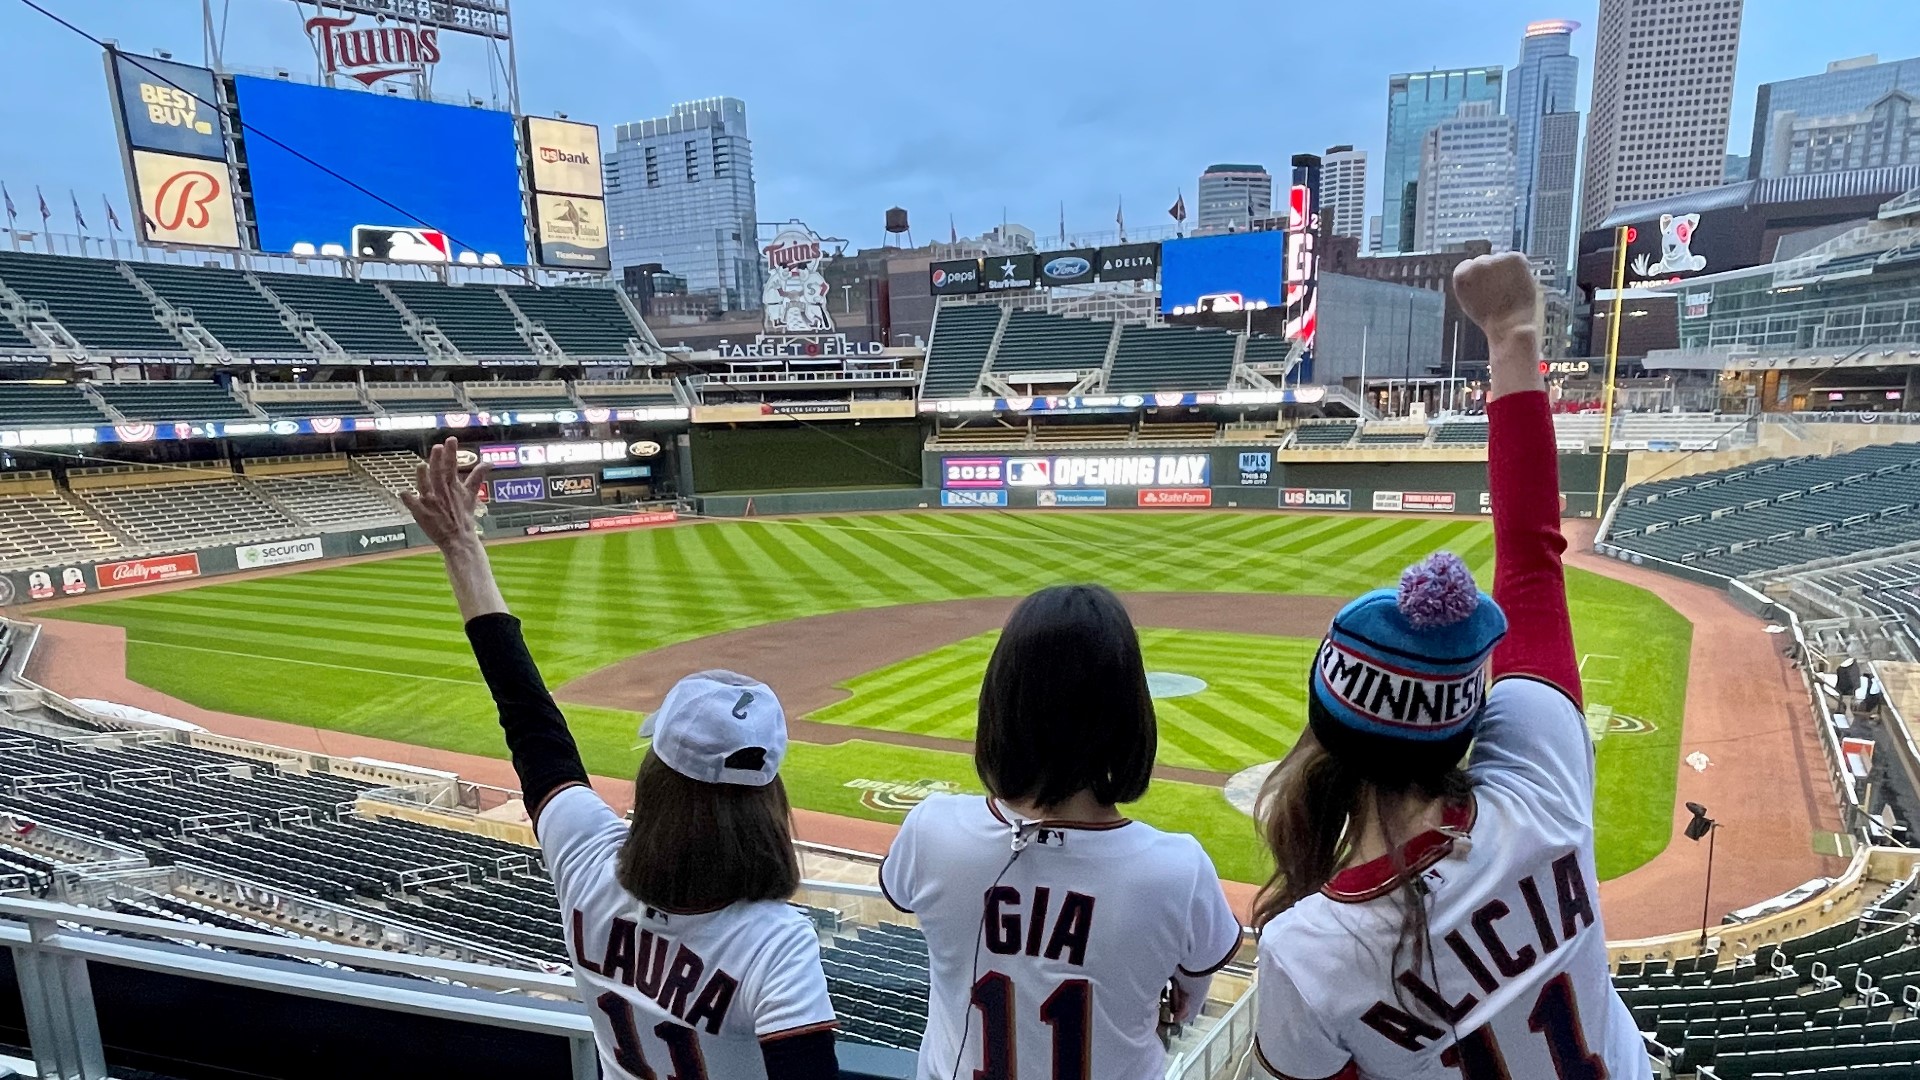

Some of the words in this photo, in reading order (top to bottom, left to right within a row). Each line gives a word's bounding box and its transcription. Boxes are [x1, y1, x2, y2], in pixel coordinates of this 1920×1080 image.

[304, 11, 441, 76] Twins
[140, 83, 199, 111] BEST
[147, 103, 197, 129] BUY
[155, 170, 220, 231] B
[763, 240, 821, 270] Twins
[1115, 256, 1153, 268] DELTA
[947, 269, 976, 284] pepsi
[1052, 262, 1081, 276] Ford
[718, 343, 802, 357] TARGET
[823, 341, 884, 356] FIELD
[1550, 361, 1590, 373] FIELD
[947, 466, 1001, 480] 2022
[1054, 456, 1156, 485] OPENING
[1242, 454, 1267, 467] MPLS
[497, 481, 541, 500] xfinity
[947, 491, 999, 505] ECOLAB
[1284, 490, 1346, 505] usbank
[262, 540, 315, 558] securian
[370, 532, 406, 545] PENTAIR
[112, 563, 150, 581] Bally
[151, 563, 177, 574] SPORTS
[984, 886, 1096, 967] GIA
[1360, 850, 1595, 1053] ALICIA
[573, 907, 739, 1036] LAURA
[597, 990, 709, 1080] 11
[970, 970, 1093, 1080] 11
[1439, 971, 1610, 1080] 11
